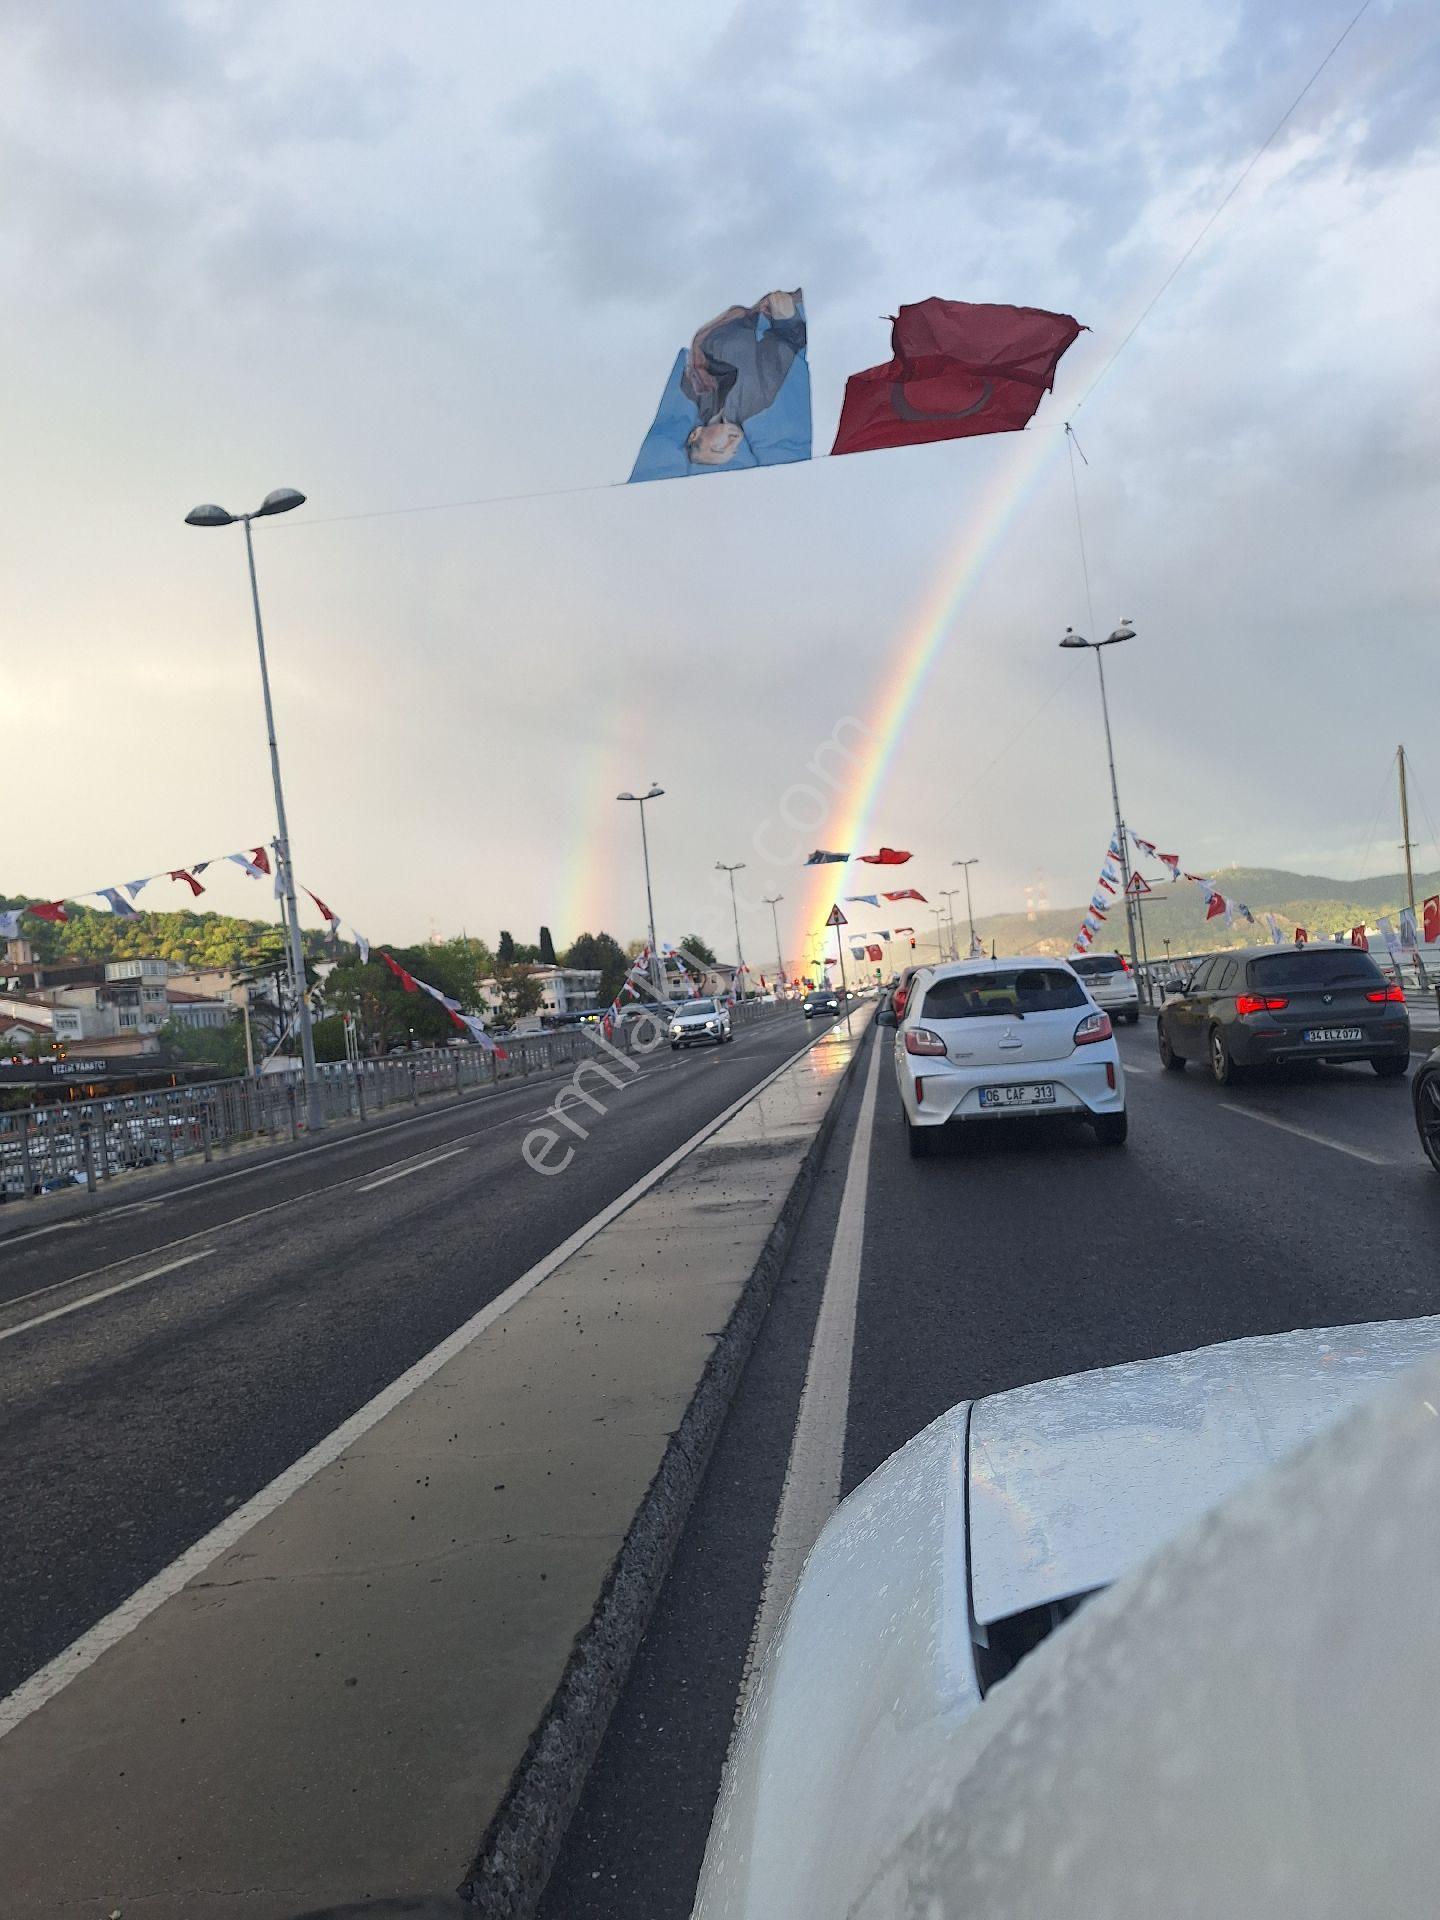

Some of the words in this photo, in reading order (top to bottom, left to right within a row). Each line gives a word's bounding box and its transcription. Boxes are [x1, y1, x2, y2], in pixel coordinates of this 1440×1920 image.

[1311, 1031, 1322, 1040] 34
[986, 1089, 1000, 1102] 06
[1006, 1087, 1025, 1100] CAF
[1034, 1086, 1052, 1098] 313
